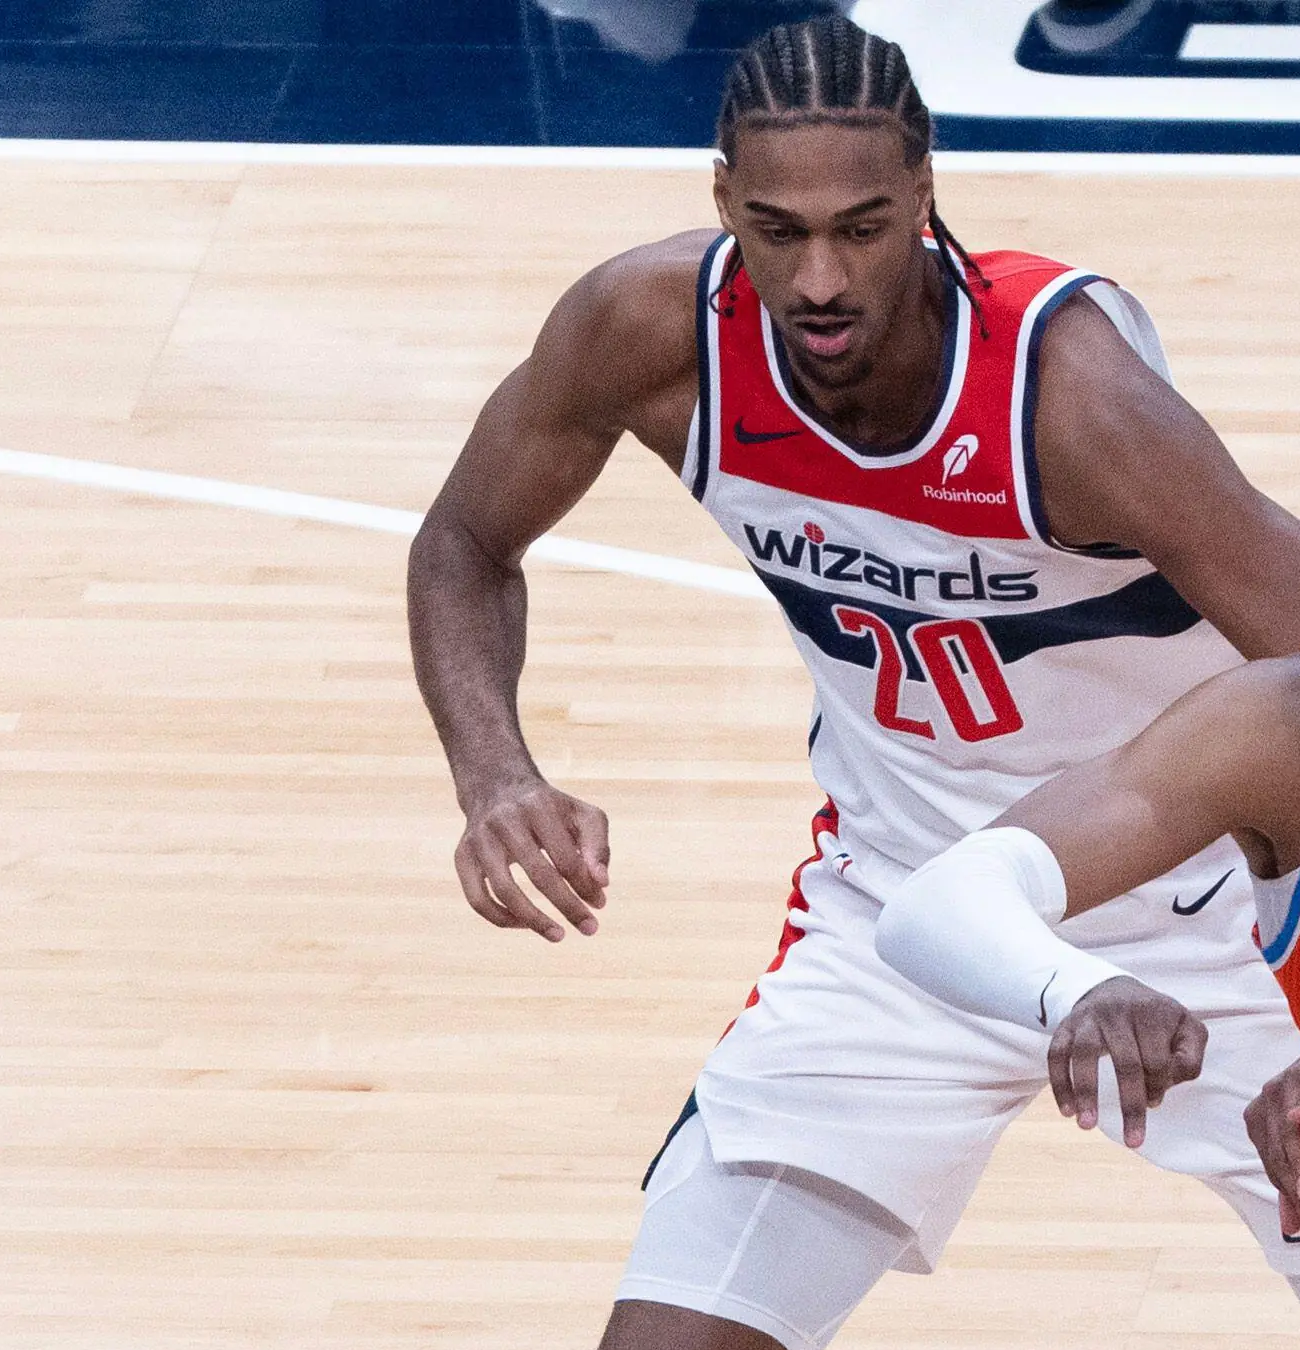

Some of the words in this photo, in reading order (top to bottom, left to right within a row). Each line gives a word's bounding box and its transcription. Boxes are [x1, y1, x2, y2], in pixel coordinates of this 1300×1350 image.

[922, 485, 1006, 504] Robinhood
[743, 522, 1039, 602] wizards
[831, 603, 1024, 743] 20
